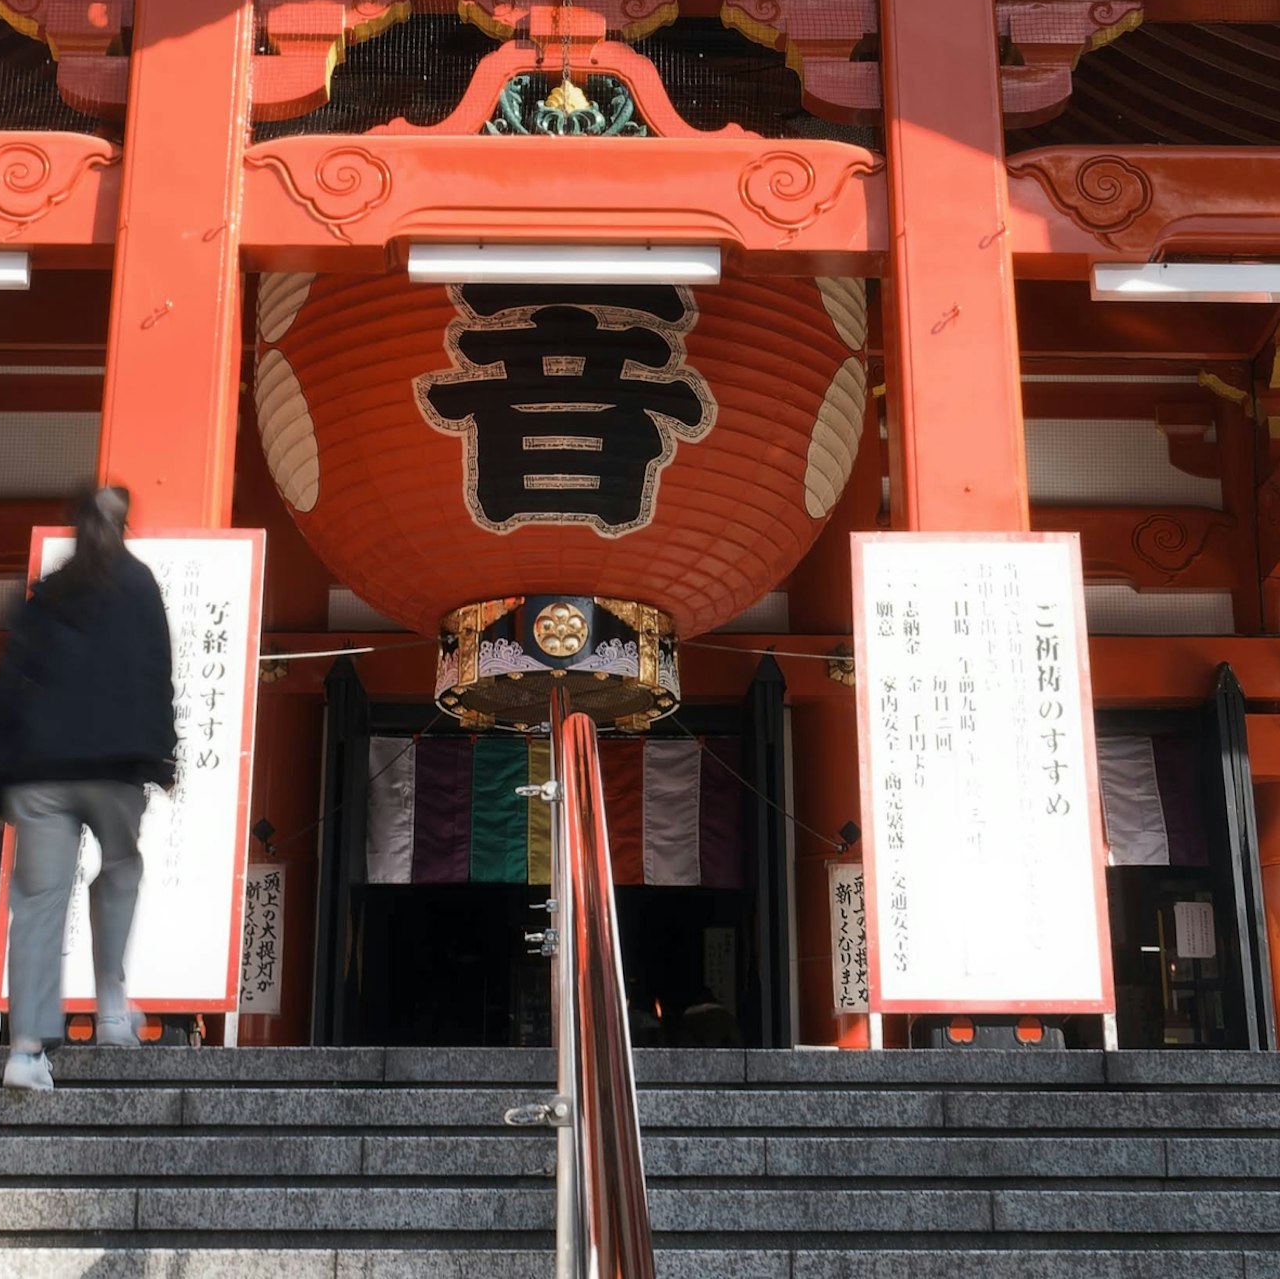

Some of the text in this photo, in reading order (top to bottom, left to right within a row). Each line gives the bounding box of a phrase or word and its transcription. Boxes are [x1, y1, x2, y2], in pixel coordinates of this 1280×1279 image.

[195, 603, 230, 771] 写経のすすめ
[1034, 604, 1070, 816] ご祈祷のすすめ
[256, 871, 280, 992] 頭上の大提灯が
[835, 883, 855, 1007] 新しくなりました
